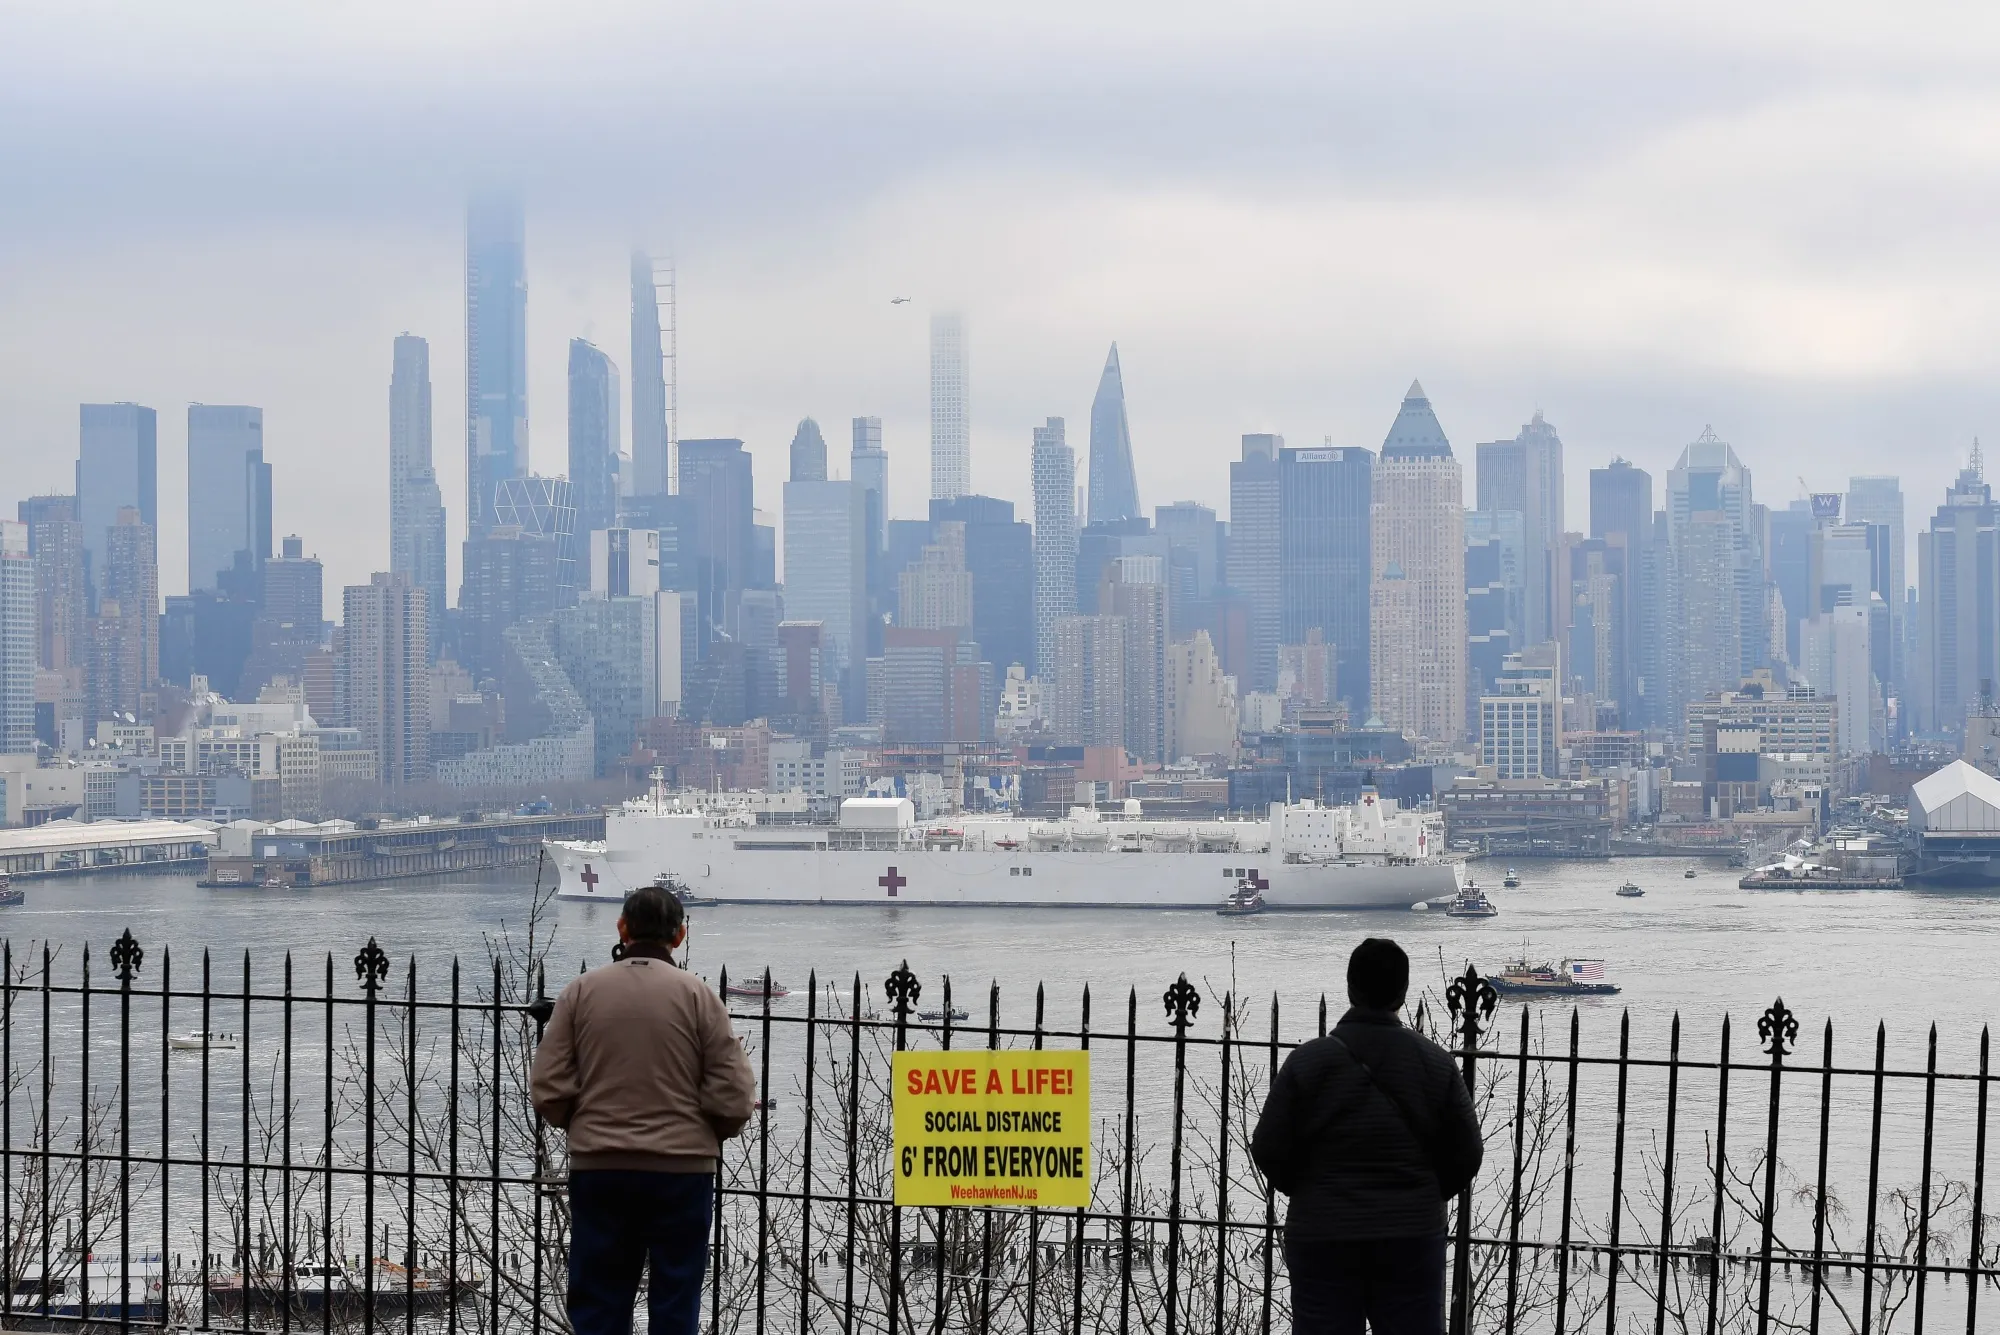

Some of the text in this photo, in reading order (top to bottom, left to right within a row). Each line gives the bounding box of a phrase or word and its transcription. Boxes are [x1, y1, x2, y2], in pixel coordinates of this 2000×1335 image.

[1301, 452, 1326, 460] Allianz
[1818, 497, 1833, 507] W
[907, 1069, 1073, 1095] SAVE A LIFE!
[924, 1111, 1062, 1133] SOCIAL DISTANCE
[901, 1146, 1084, 1179] 6' FROM EVERYONE
[951, 1185, 1038, 1200] WeehawkenNJ.us
